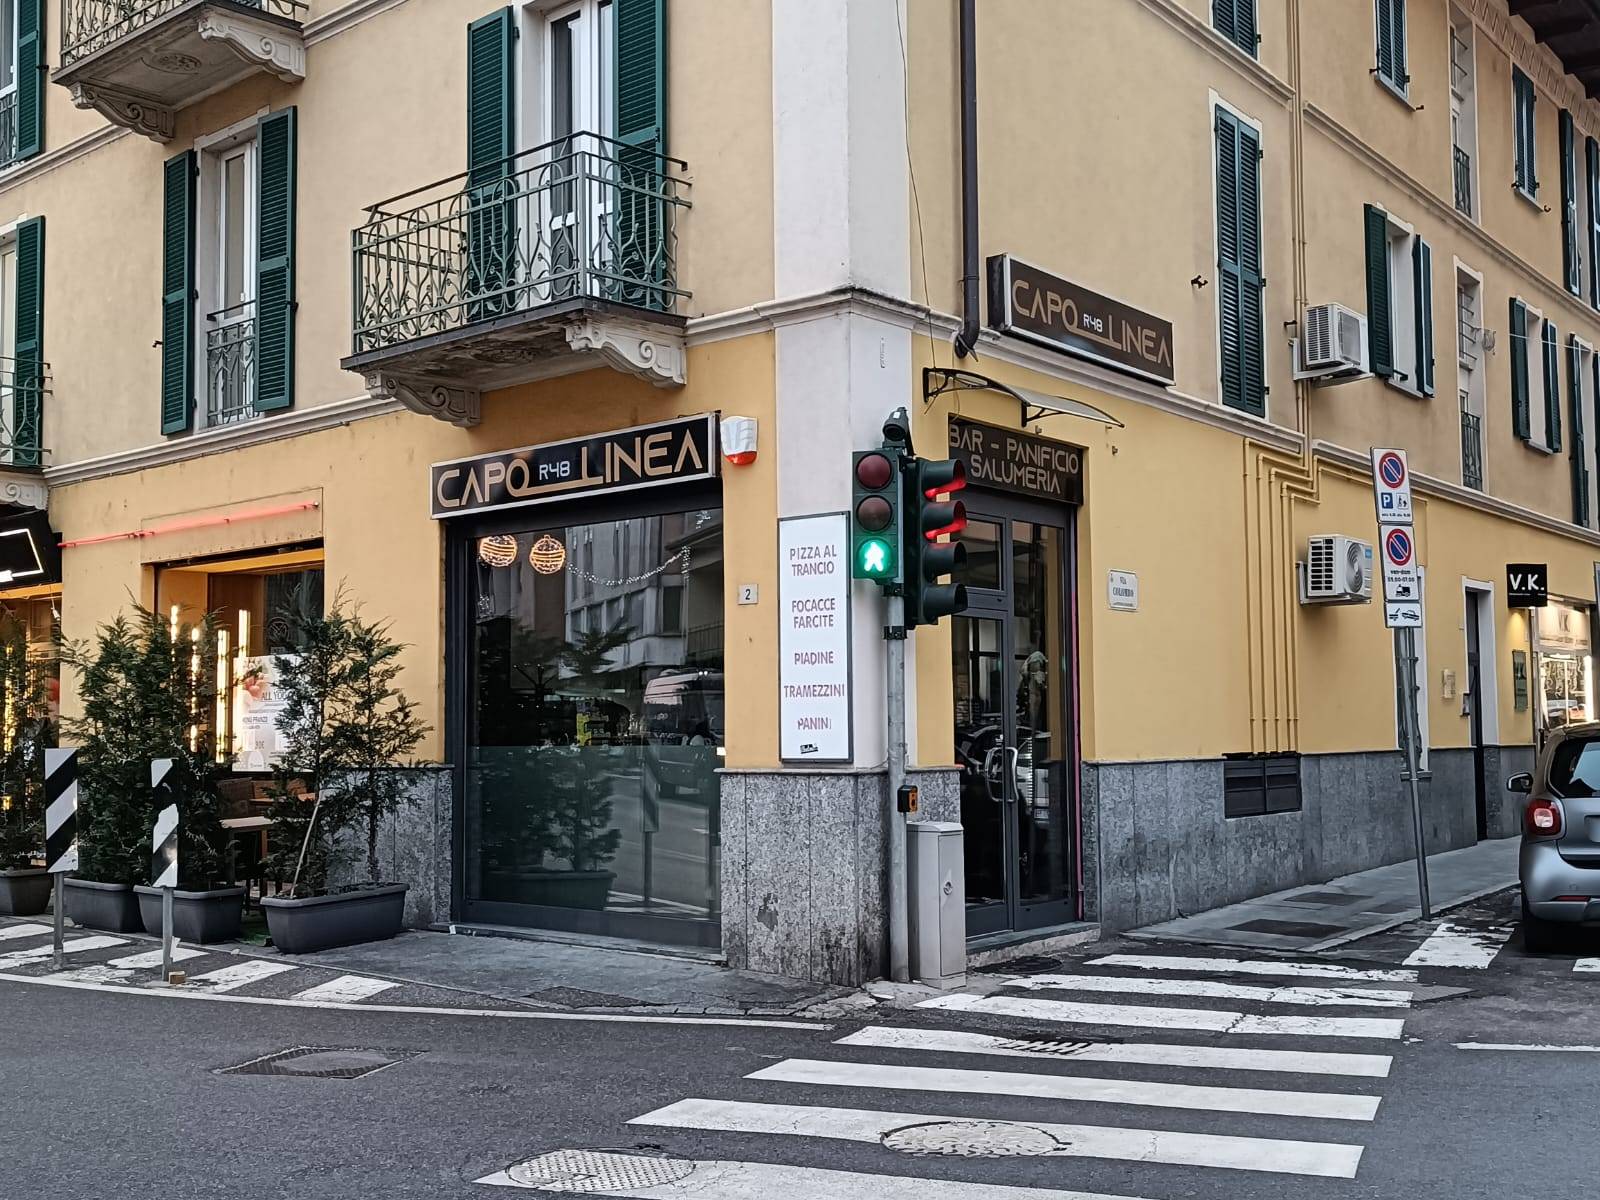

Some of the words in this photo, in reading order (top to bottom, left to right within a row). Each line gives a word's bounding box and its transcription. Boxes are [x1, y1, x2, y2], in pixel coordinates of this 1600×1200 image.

[1012, 279, 1079, 335] CAPO
[1083, 313, 1103, 333] R48
[1108, 314, 1171, 367] LINEA
[581, 429, 703, 484] LINEA
[949, 424, 984, 454] BAR
[1006, 438, 1079, 474] PANIFICIO
[538, 460, 571, 481] R48
[970, 454, 1061, 494] SALUMERIA
[436, 457, 530, 508] CAPO
[790, 546, 821, 560] PIZZA
[823, 544, 837, 558] AL
[791, 560, 835, 577] TRANCIO
[1509, 573, 1545, 591] V.K.
[745, 588, 751, 600] 2
[791, 598, 836, 613] FOCACCE
[793, 615, 834, 629] FARCITE
[794, 651, 834, 666] PIADINE
[784, 684, 845, 698] TRAMEZZINI
[797, 717, 832, 730] PANINI
